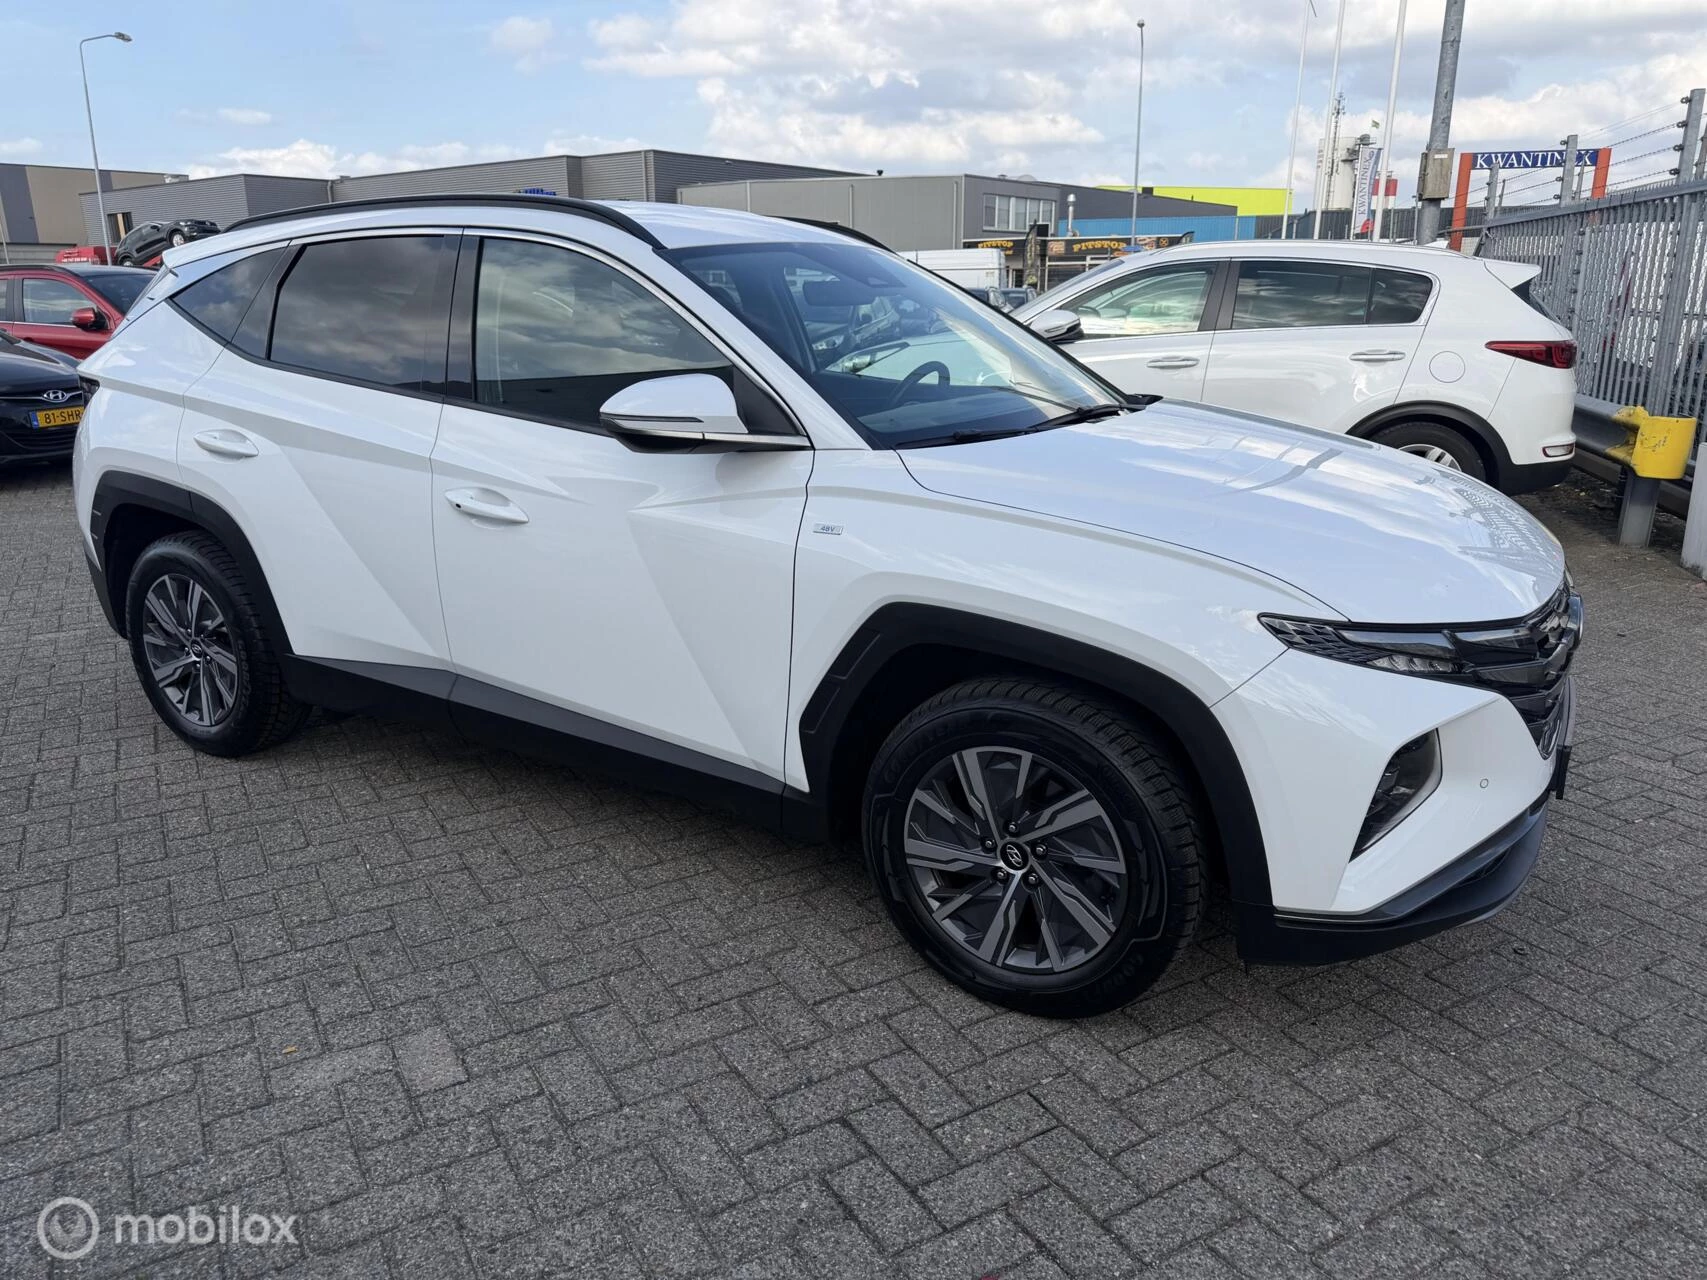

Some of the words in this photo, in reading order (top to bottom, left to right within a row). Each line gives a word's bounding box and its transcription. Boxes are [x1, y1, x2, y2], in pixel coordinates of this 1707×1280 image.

[1475, 151, 1595, 169] KWANTINX
[1072, 240, 1127, 252] PITSTOP
[44, 409, 82, 425] 81-SHR
